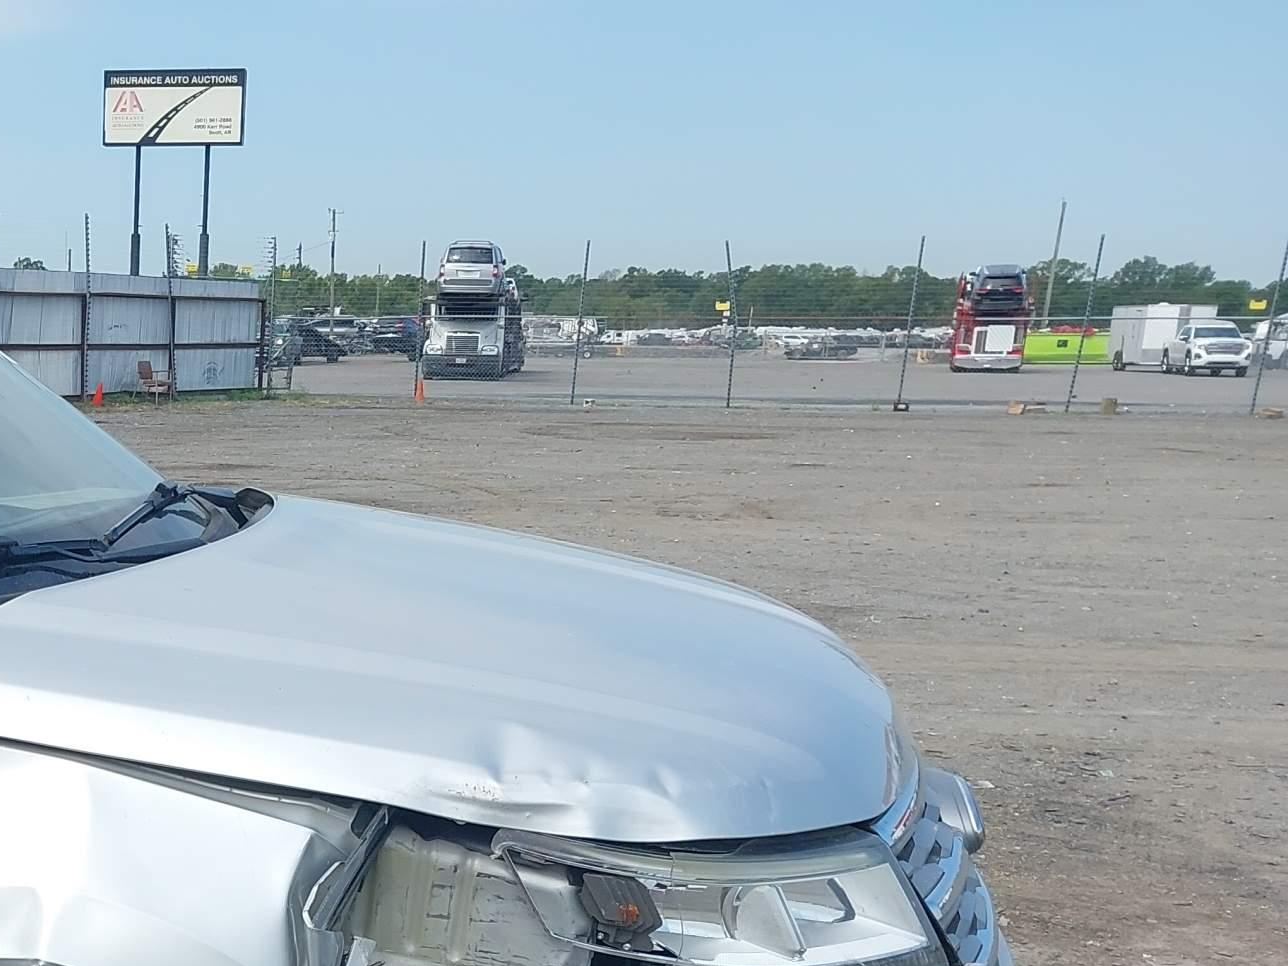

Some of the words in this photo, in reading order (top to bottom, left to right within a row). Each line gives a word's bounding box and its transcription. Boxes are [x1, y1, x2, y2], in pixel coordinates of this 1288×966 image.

[111, 76, 162, 85] INSURANCE
[164, 76, 189, 84] AUTO
[191, 75, 238, 84] AUCTIONS
